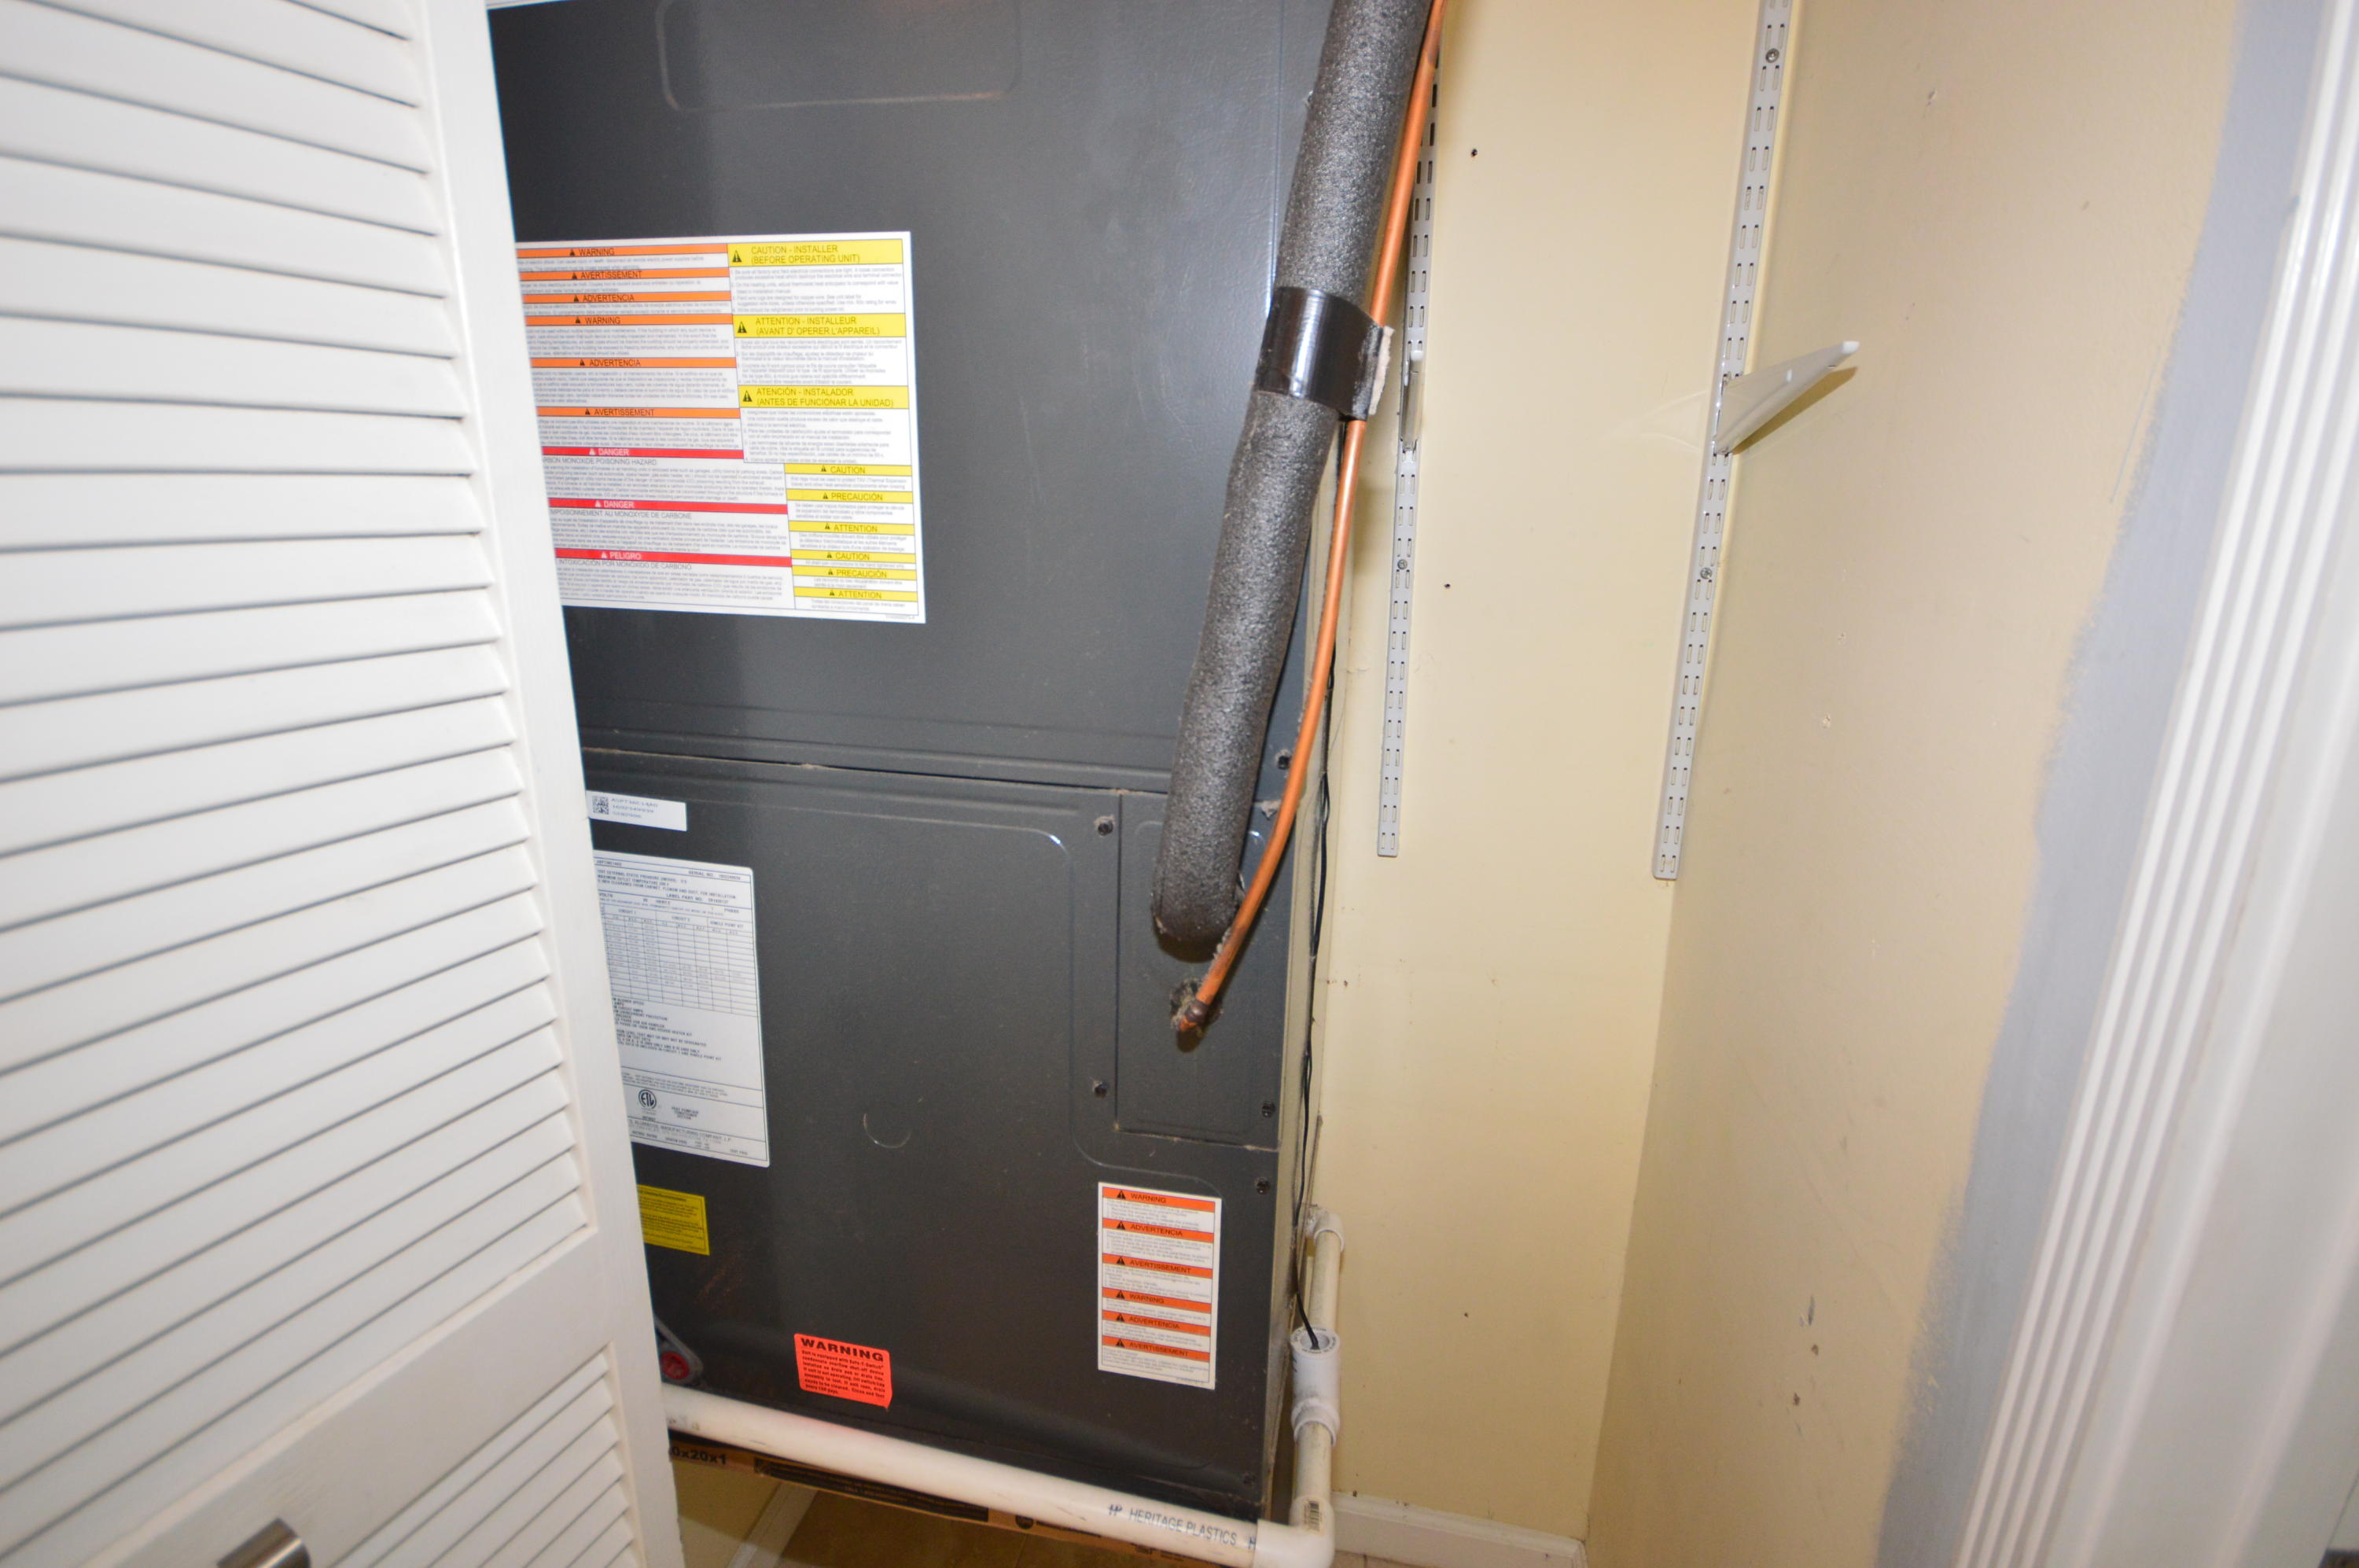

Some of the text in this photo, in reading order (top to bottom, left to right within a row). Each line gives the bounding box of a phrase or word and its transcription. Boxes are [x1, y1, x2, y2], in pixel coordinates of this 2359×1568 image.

[579, 248, 615, 256] WARNING
[751, 245, 786, 254] CAUTION
[793, 245, 838, 253] INSTALLER
[751, 254, 860, 264] (BEFORE OPERATING UNIT)
[581, 271, 642, 279] AVERTISSEMENT
[585, 316, 620, 325] WARNING
[807, 316, 856, 325] INSTALLEUR
[756, 327, 784, 336] (AVANT
[797, 326, 830, 335] OPERER
[756, 387, 797, 396] ATENCIÓN
[803, 388, 854, 396] INSTALADOR
[756, 398, 785, 407] (ANTES
[800, 398, 847, 407] FUNCIONAR
[862, 399, 893, 407] UNIDAD)
[594, 408, 655, 417] AVERTISSEMENT
[598, 447, 629, 456] DANGER
[830, 466, 866, 474] CAUTION
[831, 492, 883, 501] PRECAUCIÓN
[604, 500, 635, 509] DANGER
[609, 552, 642, 561] PELIGRO
[836, 569, 887, 578] PRECAUCIÓN
[839, 591, 882, 599] ATTENTION
[1131, 1193, 1166, 1203] WARNING
[1131, 1224, 1183, 1236] ADVERTENCIA
[1130, 1260, 1191, 1274] AVERTISSEMENT
[1130, 1294, 1165, 1304] WARNING
[1129, 1316, 1180, 1329] ADVERTENCIA
[801, 1338, 883, 1362] WARNING
[1130, 1342, 1188, 1356] AVERTISSEMENT
[668, 1446, 727, 1465] 0x20x1
[1129, 1508, 1183, 1533] HERITAGE
[1186, 1521, 1237, 1546] PLASTICS
[1248, 1537, 1257, 1551] H
